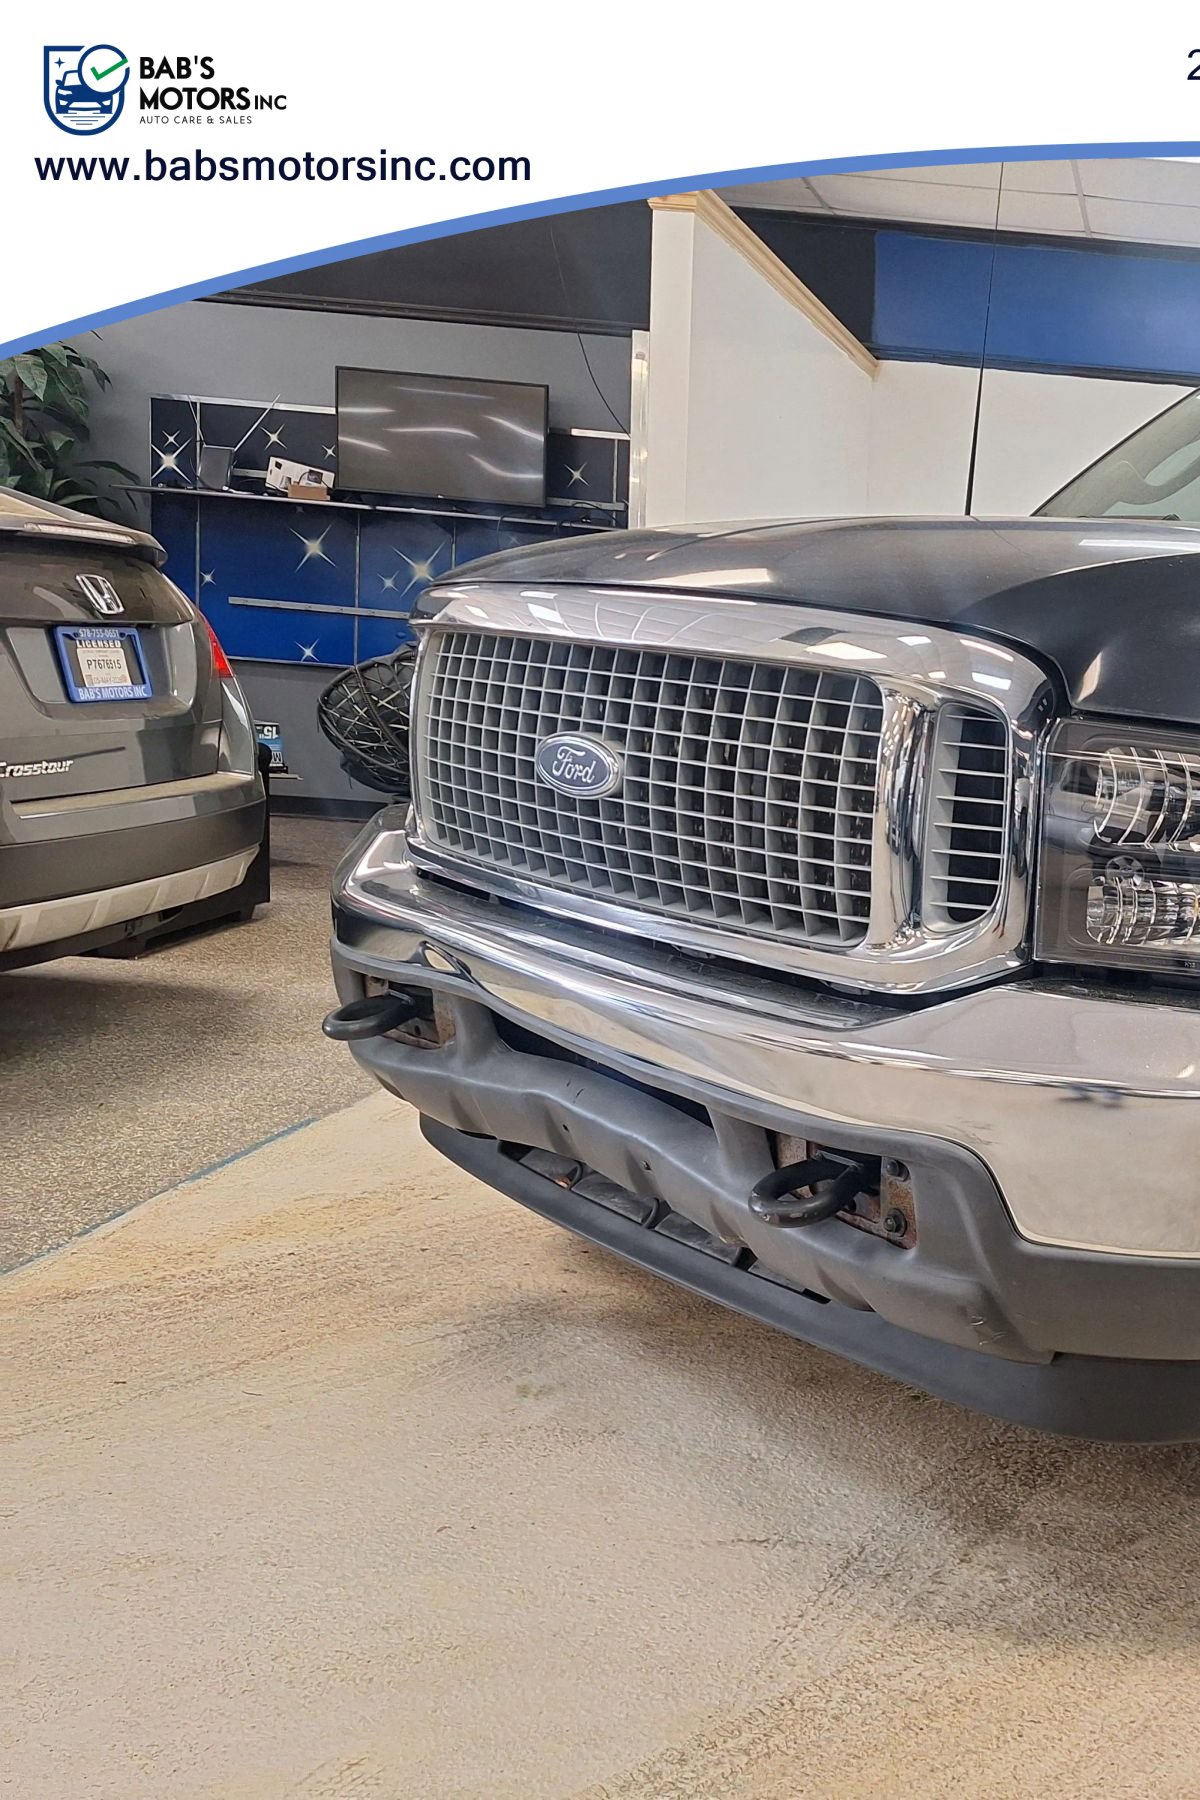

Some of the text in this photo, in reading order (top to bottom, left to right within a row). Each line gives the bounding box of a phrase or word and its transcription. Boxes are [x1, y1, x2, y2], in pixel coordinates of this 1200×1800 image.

[76, 640, 121, 648] LICENSED
[79, 686, 148, 700] BAB'S MOTORS INC
[0, 760, 74, 777] Crosstour
[552, 746, 596, 784] Ford
